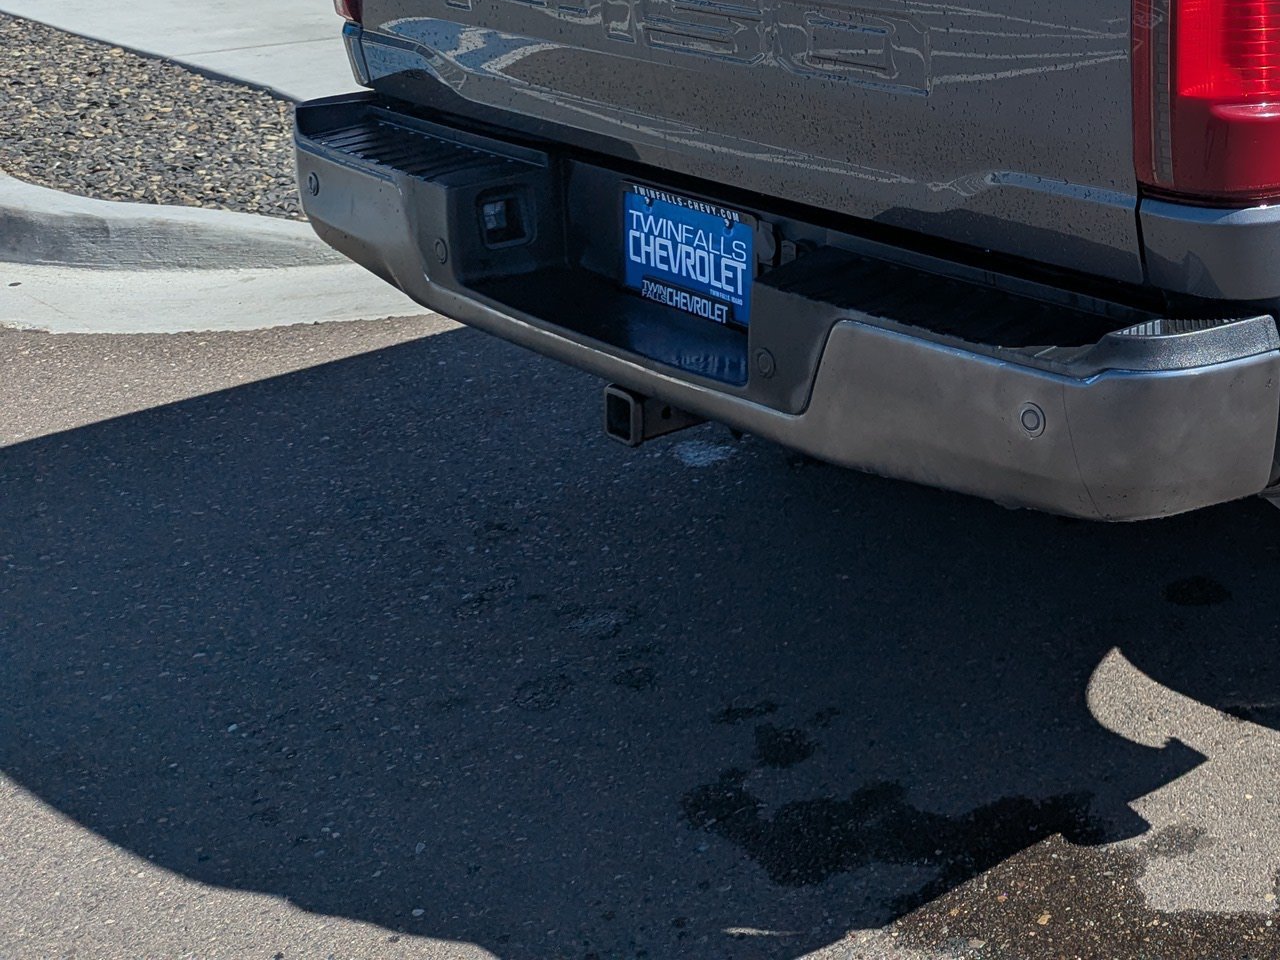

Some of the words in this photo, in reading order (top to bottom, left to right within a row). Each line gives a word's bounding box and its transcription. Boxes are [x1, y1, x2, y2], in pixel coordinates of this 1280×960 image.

[629, 230, 747, 296] CHEVROLET
[641, 288, 667, 304] FALLS
[666, 287, 729, 324] CHEVROLET
[642, 279, 667, 296] TWIN
